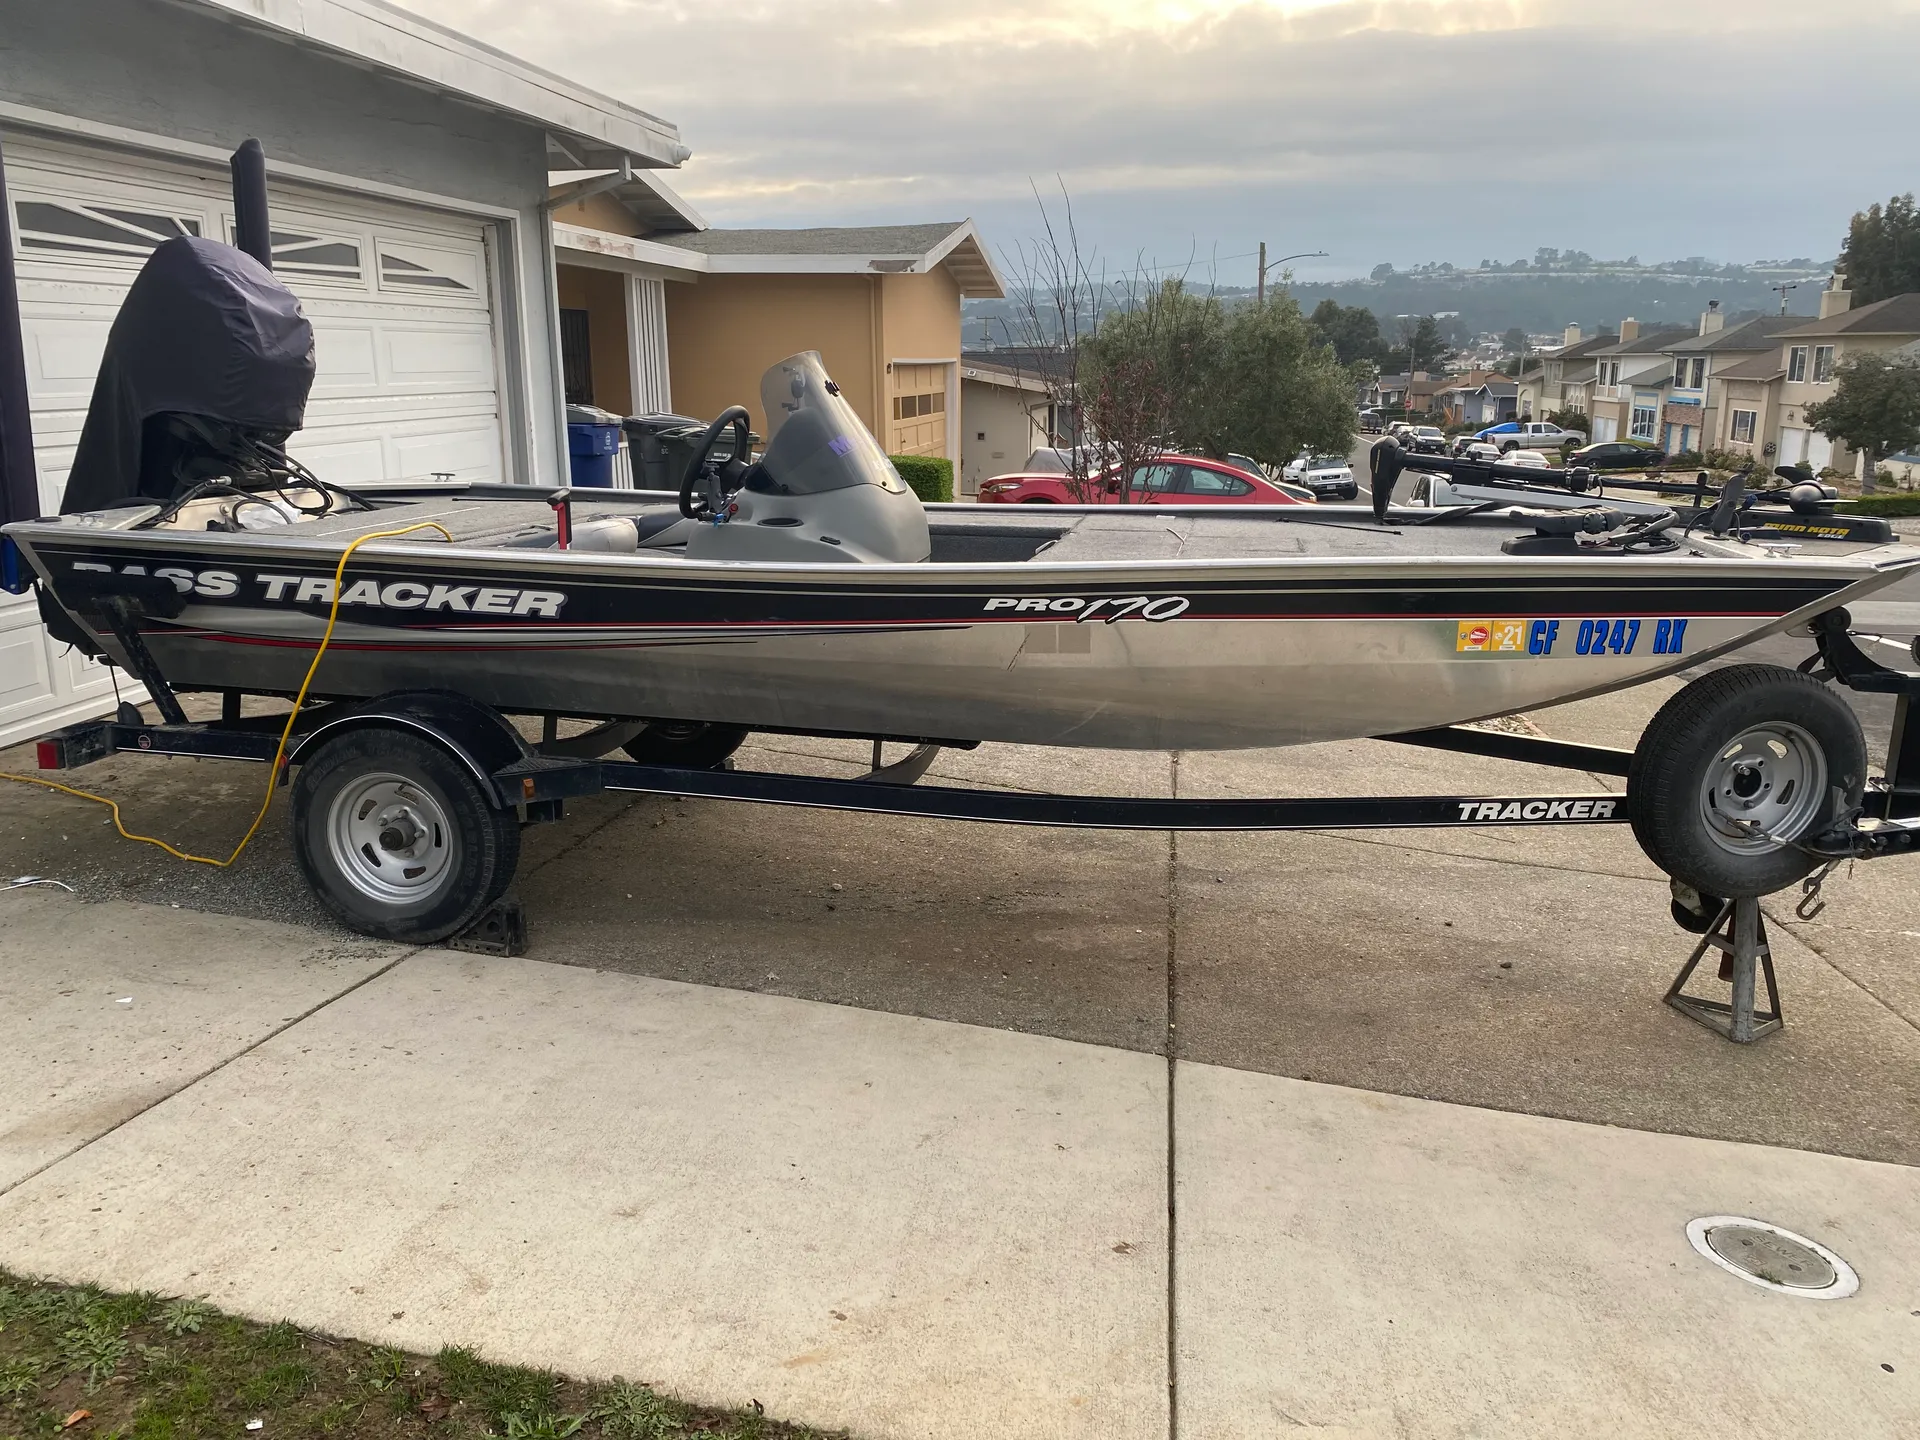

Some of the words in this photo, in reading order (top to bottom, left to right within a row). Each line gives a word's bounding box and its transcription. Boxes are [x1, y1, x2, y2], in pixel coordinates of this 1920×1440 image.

[1807, 526, 1851, 536] KOTA
[72, 562, 240, 597] SS
[256, 574, 567, 617] TRACKER
[1502, 625, 1523, 645] 21
[1528, 620, 1559, 655] CF
[1575, 620, 1640, 654] 0247
[1652, 619, 1688, 654] RX
[1458, 801, 1617, 820] TRACKER
